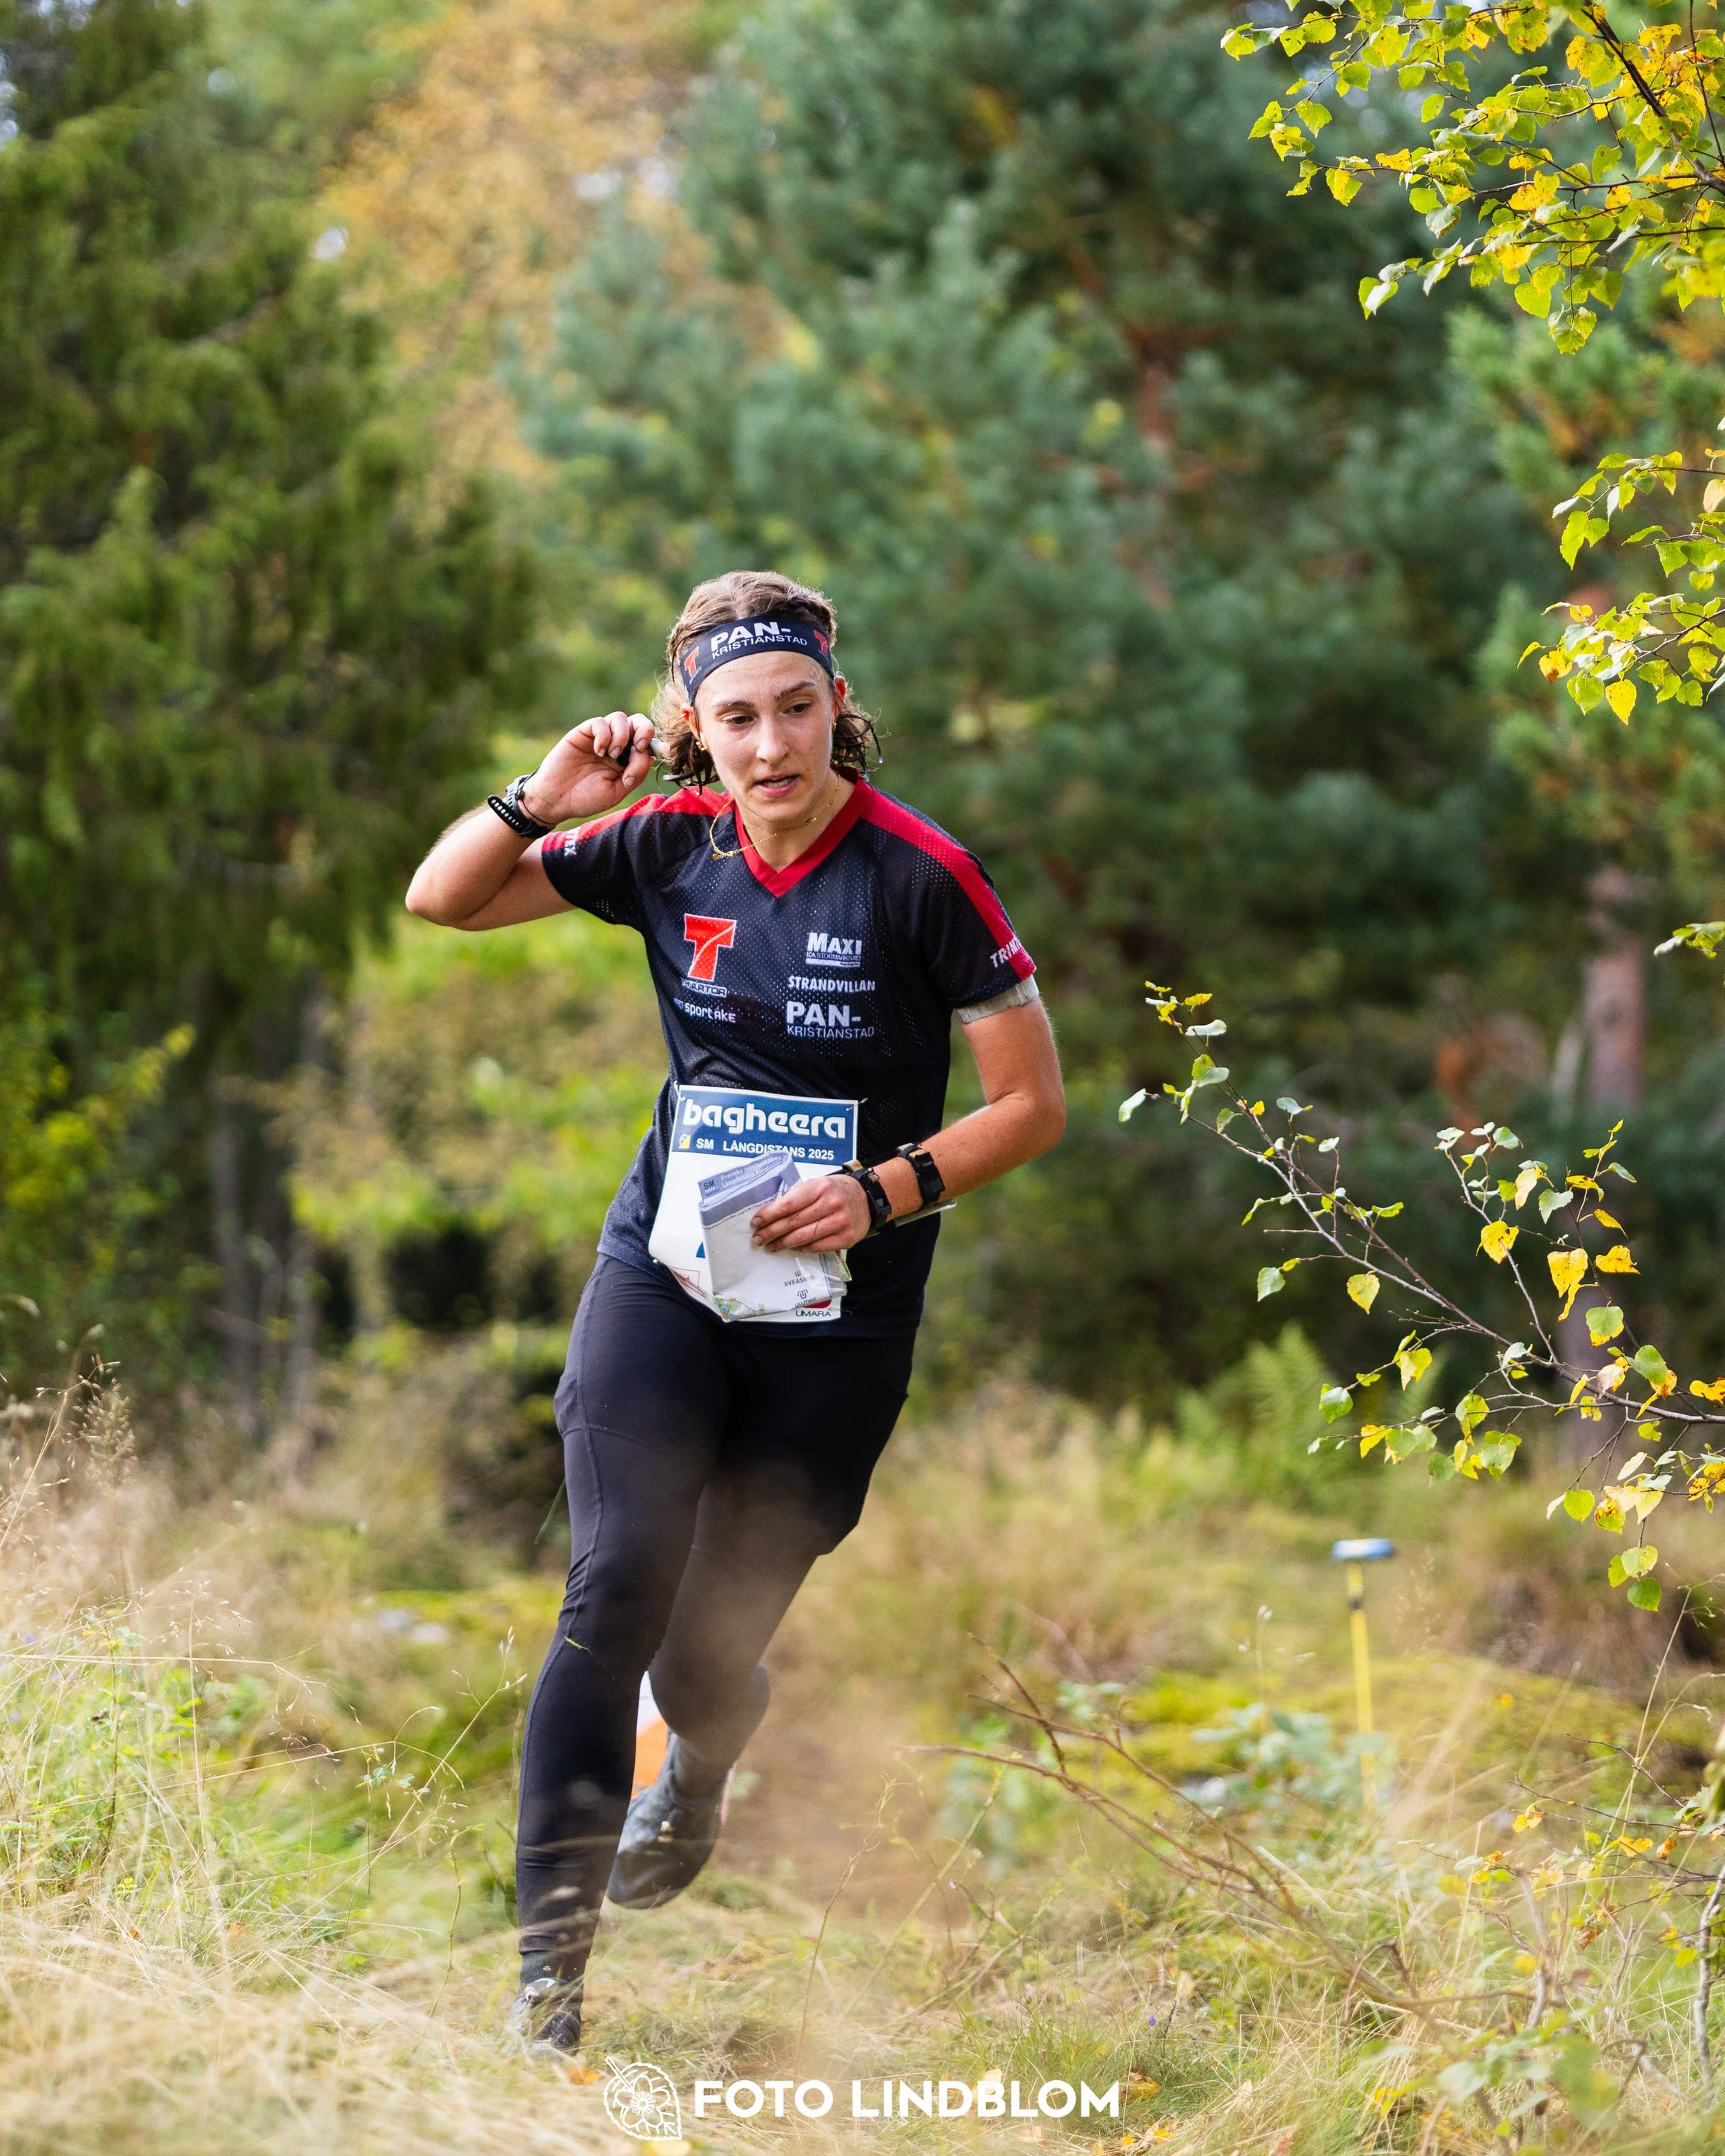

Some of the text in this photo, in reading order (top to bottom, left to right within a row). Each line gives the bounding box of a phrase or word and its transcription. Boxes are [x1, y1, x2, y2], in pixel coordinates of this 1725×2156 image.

[711, 622, 791, 652] PAN-
[711, 635, 807, 660] KRISTIANSTAD
[807, 932, 862, 955] MAXI
[788, 976, 875, 993] STRANDVILLAN
[684, 1002, 713, 1020] sport
[787, 1000, 861, 1027] PAN-
[787, 1025, 874, 1038] KRISTIANSTAD
[682, 1098, 845, 1138] bagheera
[696, 1138, 714, 1149] SM
[808, 1148, 834, 1160] 2025
[703, 1179, 716, 1189] SM
